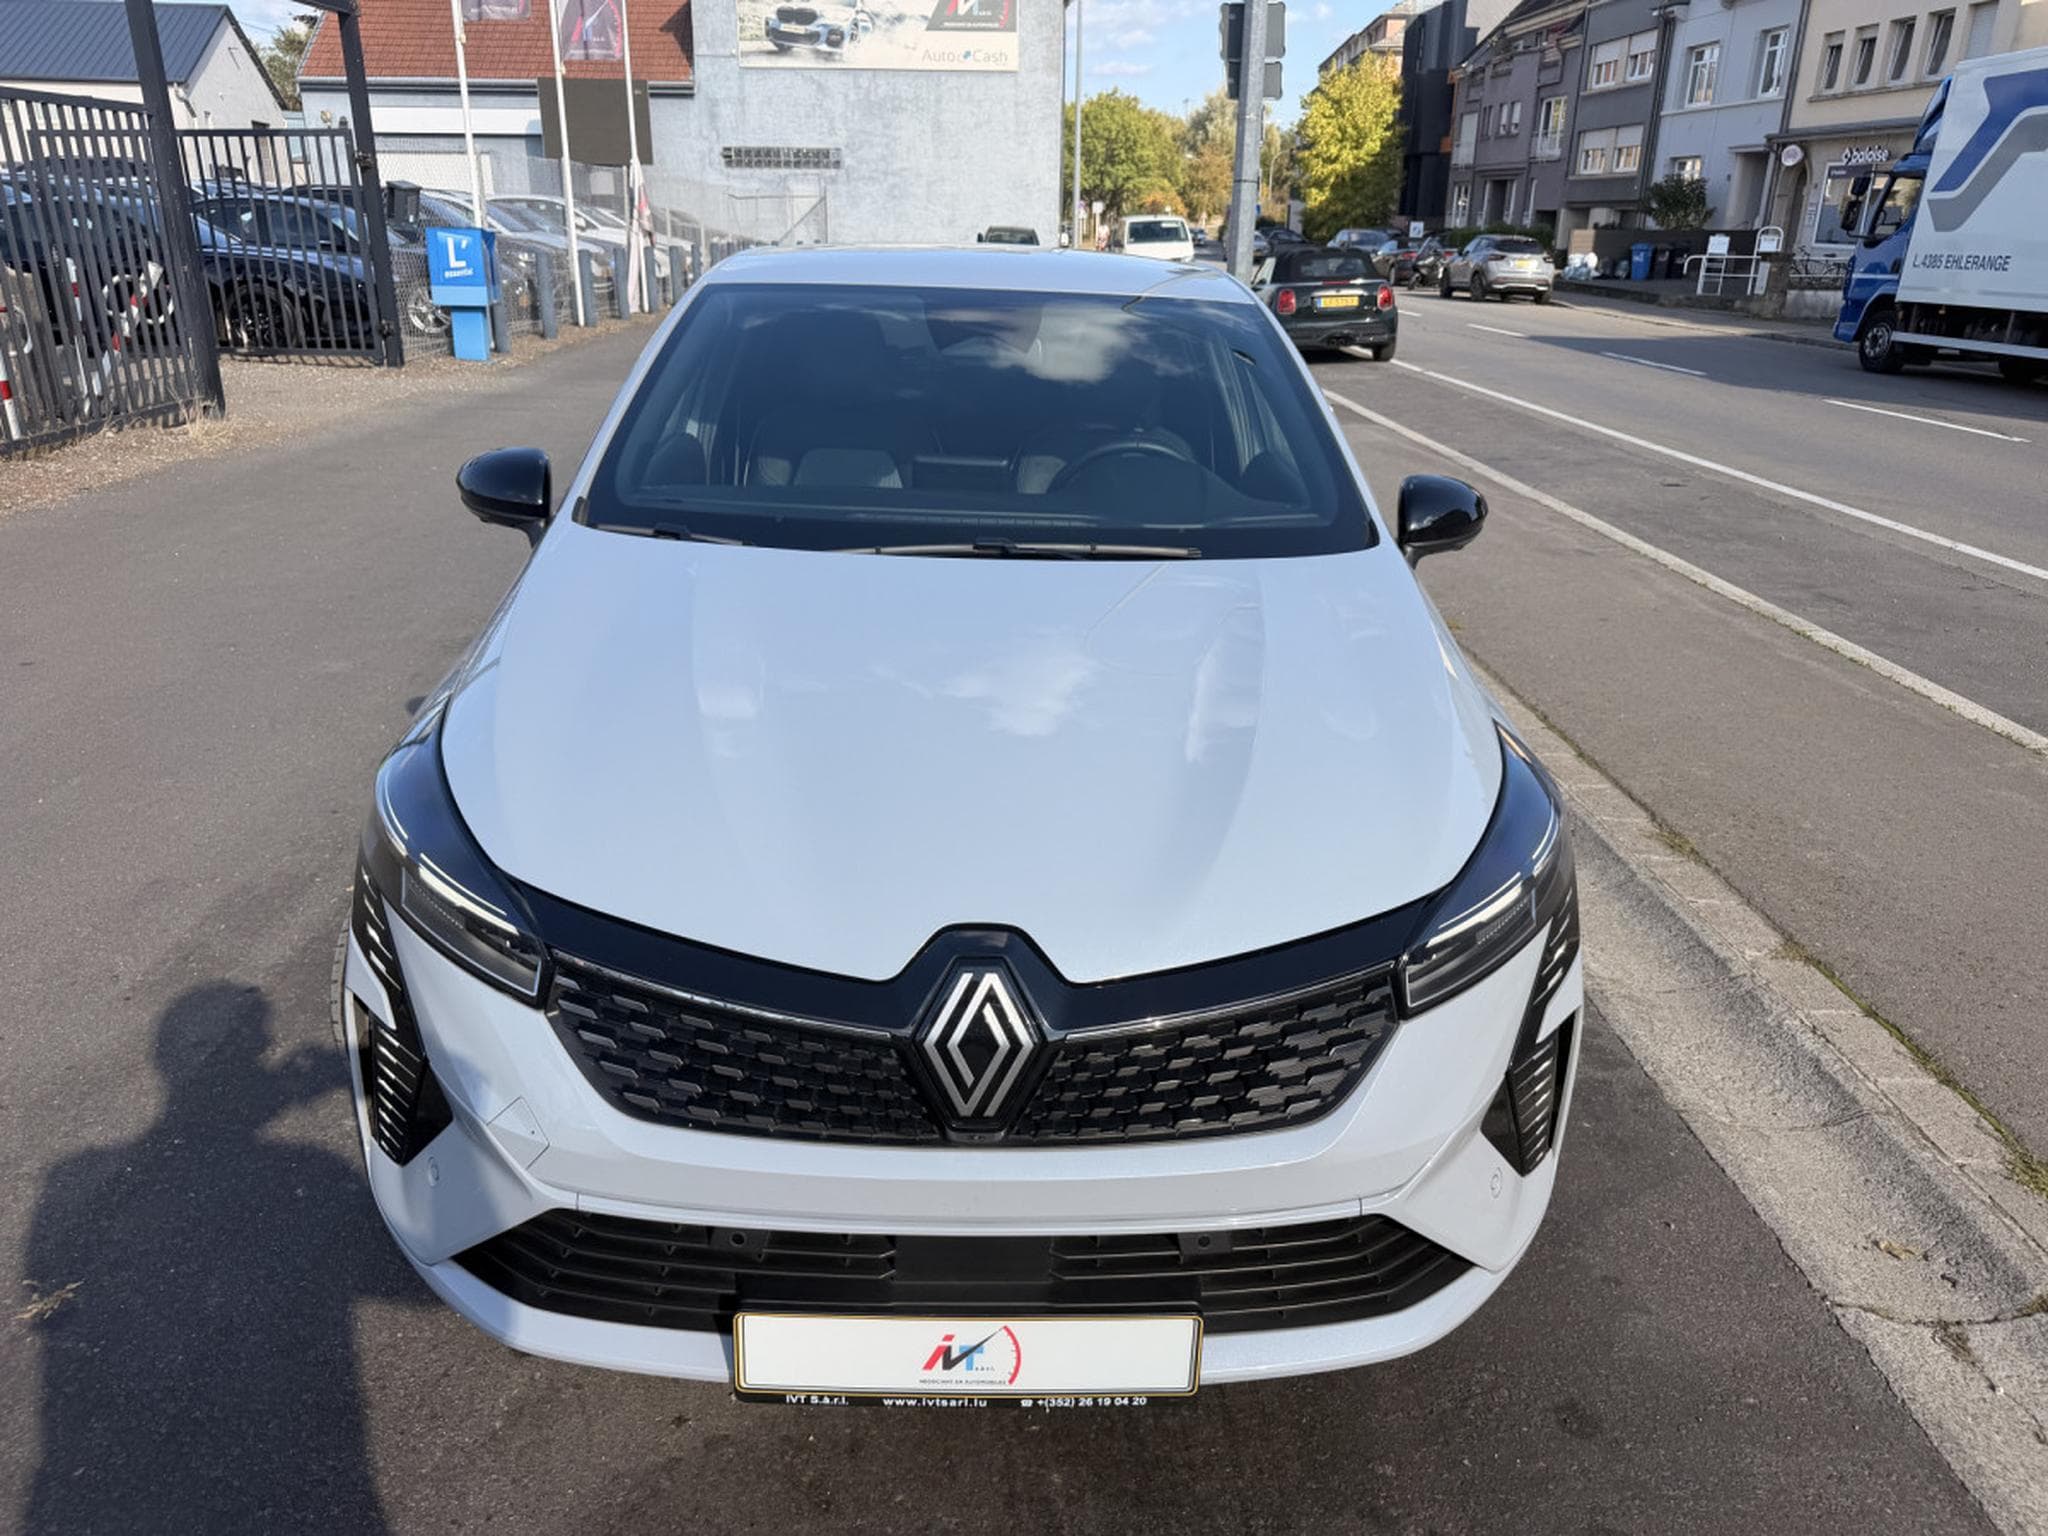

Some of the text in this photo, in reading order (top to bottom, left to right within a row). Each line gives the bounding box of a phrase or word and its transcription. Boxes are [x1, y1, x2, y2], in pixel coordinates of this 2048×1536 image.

[973, 49, 1009, 63] Cash
[1852, 145, 1889, 162] baloise
[1944, 254, 2012, 271] EHLERANGE
[786, 1394, 807, 1404] IVT
[882, 1397, 988, 1407] www.ivtsarl.lu
[1078, 1397, 1094, 1406] 26
[1097, 1397, 1111, 1406] 19
[1114, 1397, 1129, 1406] 04
[1132, 1396, 1148, 1405] 20
